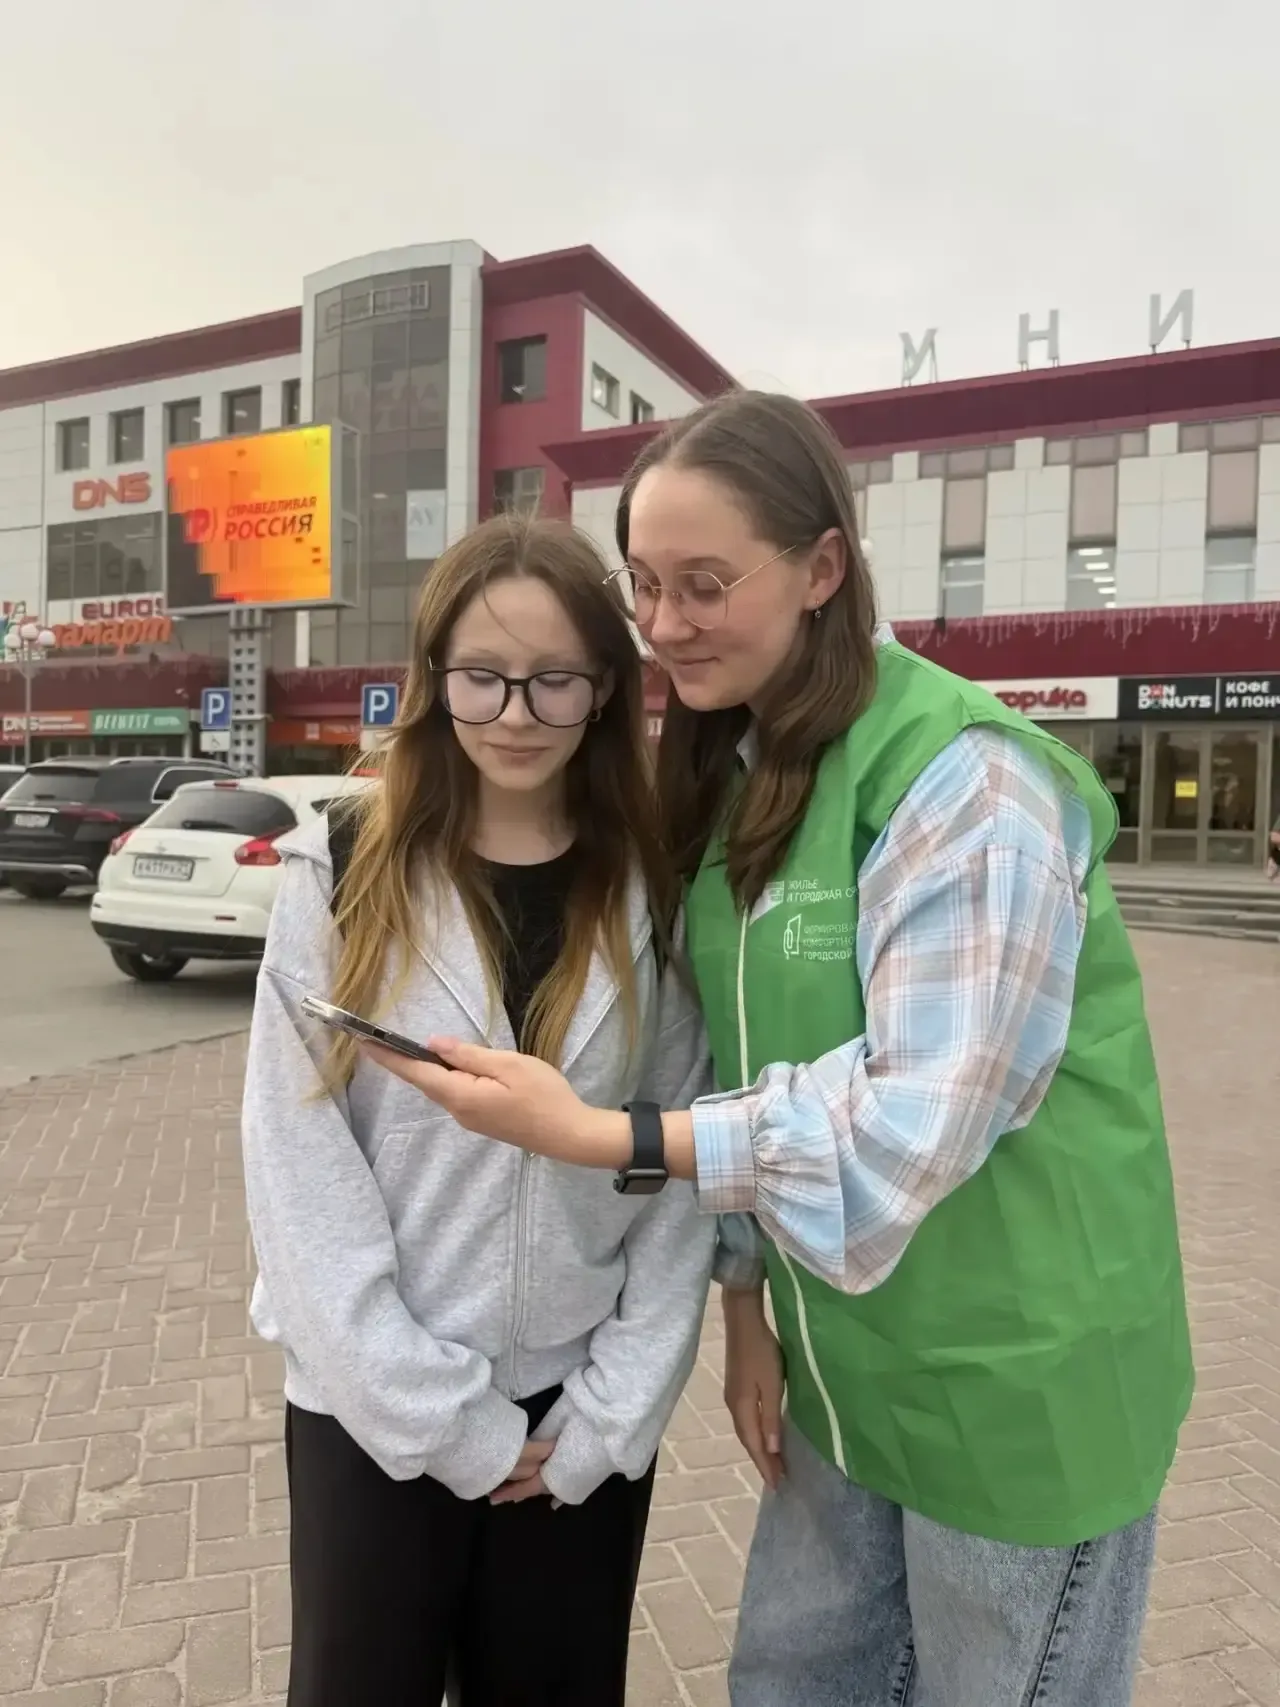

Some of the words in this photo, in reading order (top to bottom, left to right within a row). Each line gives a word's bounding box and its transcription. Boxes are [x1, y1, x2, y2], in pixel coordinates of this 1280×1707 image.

[72, 471, 152, 511] DNS
[226, 496, 317, 518] СПРАВЕДЛИВАЯ
[224, 513, 313, 540] РОССИЯ
[1226, 681, 1270, 694] КОФЕ
[1225, 696, 1239, 708] И
[3, 716, 40, 732] DNS
[794, 888, 842, 903] ГОРОДСКАЯ
